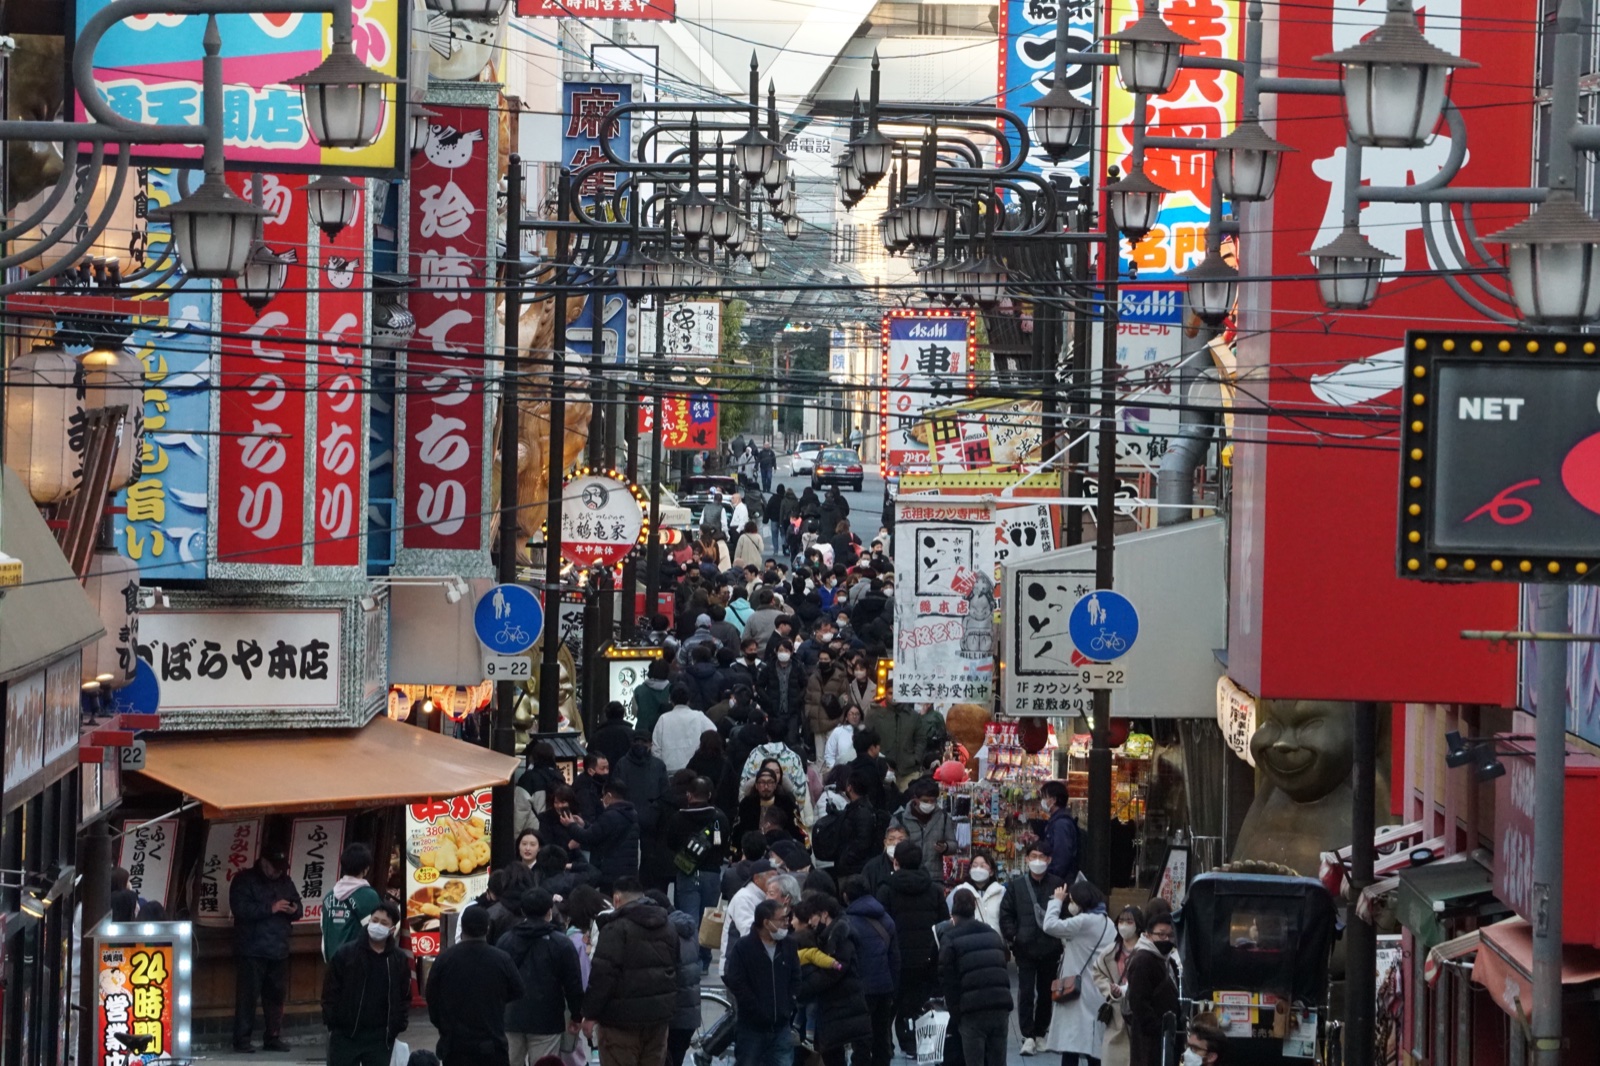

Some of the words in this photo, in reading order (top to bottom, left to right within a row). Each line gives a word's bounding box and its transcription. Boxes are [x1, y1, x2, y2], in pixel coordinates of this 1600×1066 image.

[1101, 291, 1175, 316] sahi
[909, 323, 947, 338] Asahi
[1116, 324, 1170, 336] サヒビール
[413, 181, 475, 536] 珍味てっちり
[1458, 397, 1525, 421] NET
[236, 312, 289, 539] てっちり
[319, 313, 358, 540] てっちり
[901, 507, 991, 520] 元祖串カツ専門店
[576, 519, 627, 541] 鶴亀家
[575, 544, 614, 556] 年中無休
[487, 662, 528, 675] 9-22
[1082, 671, 1124, 684] 9-22
[898, 682, 989, 698] 宴会予約受付中
[1033, 682, 1084, 694] カウンタ
[149, 825, 166, 861] ふぐ
[301, 824, 328, 899] ふぐ唐揚
[130, 951, 168, 1055] 24時間
